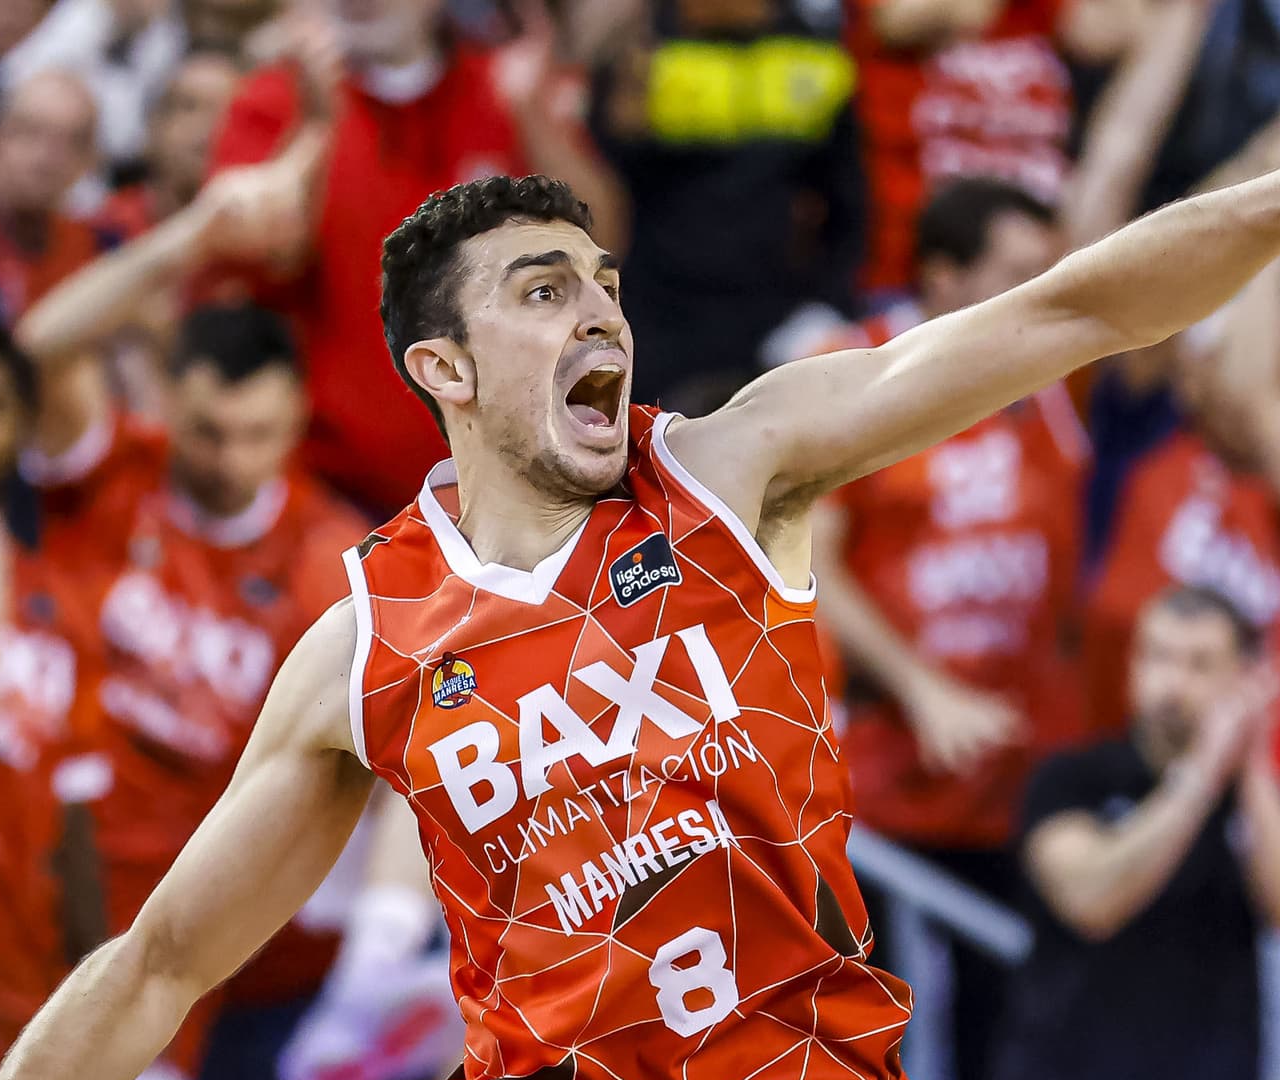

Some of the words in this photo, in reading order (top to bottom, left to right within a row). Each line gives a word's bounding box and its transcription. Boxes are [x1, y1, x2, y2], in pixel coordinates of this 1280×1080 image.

[616, 562, 643, 586] liga
[622, 565, 676, 597] endesa
[426, 623, 741, 836] BAXI
[434, 677, 477, 705] MANRESA
[483, 730, 759, 874] CLIMATIZACIÓN
[544, 799, 741, 937] MANRESA
[649, 926, 739, 1038] 8
